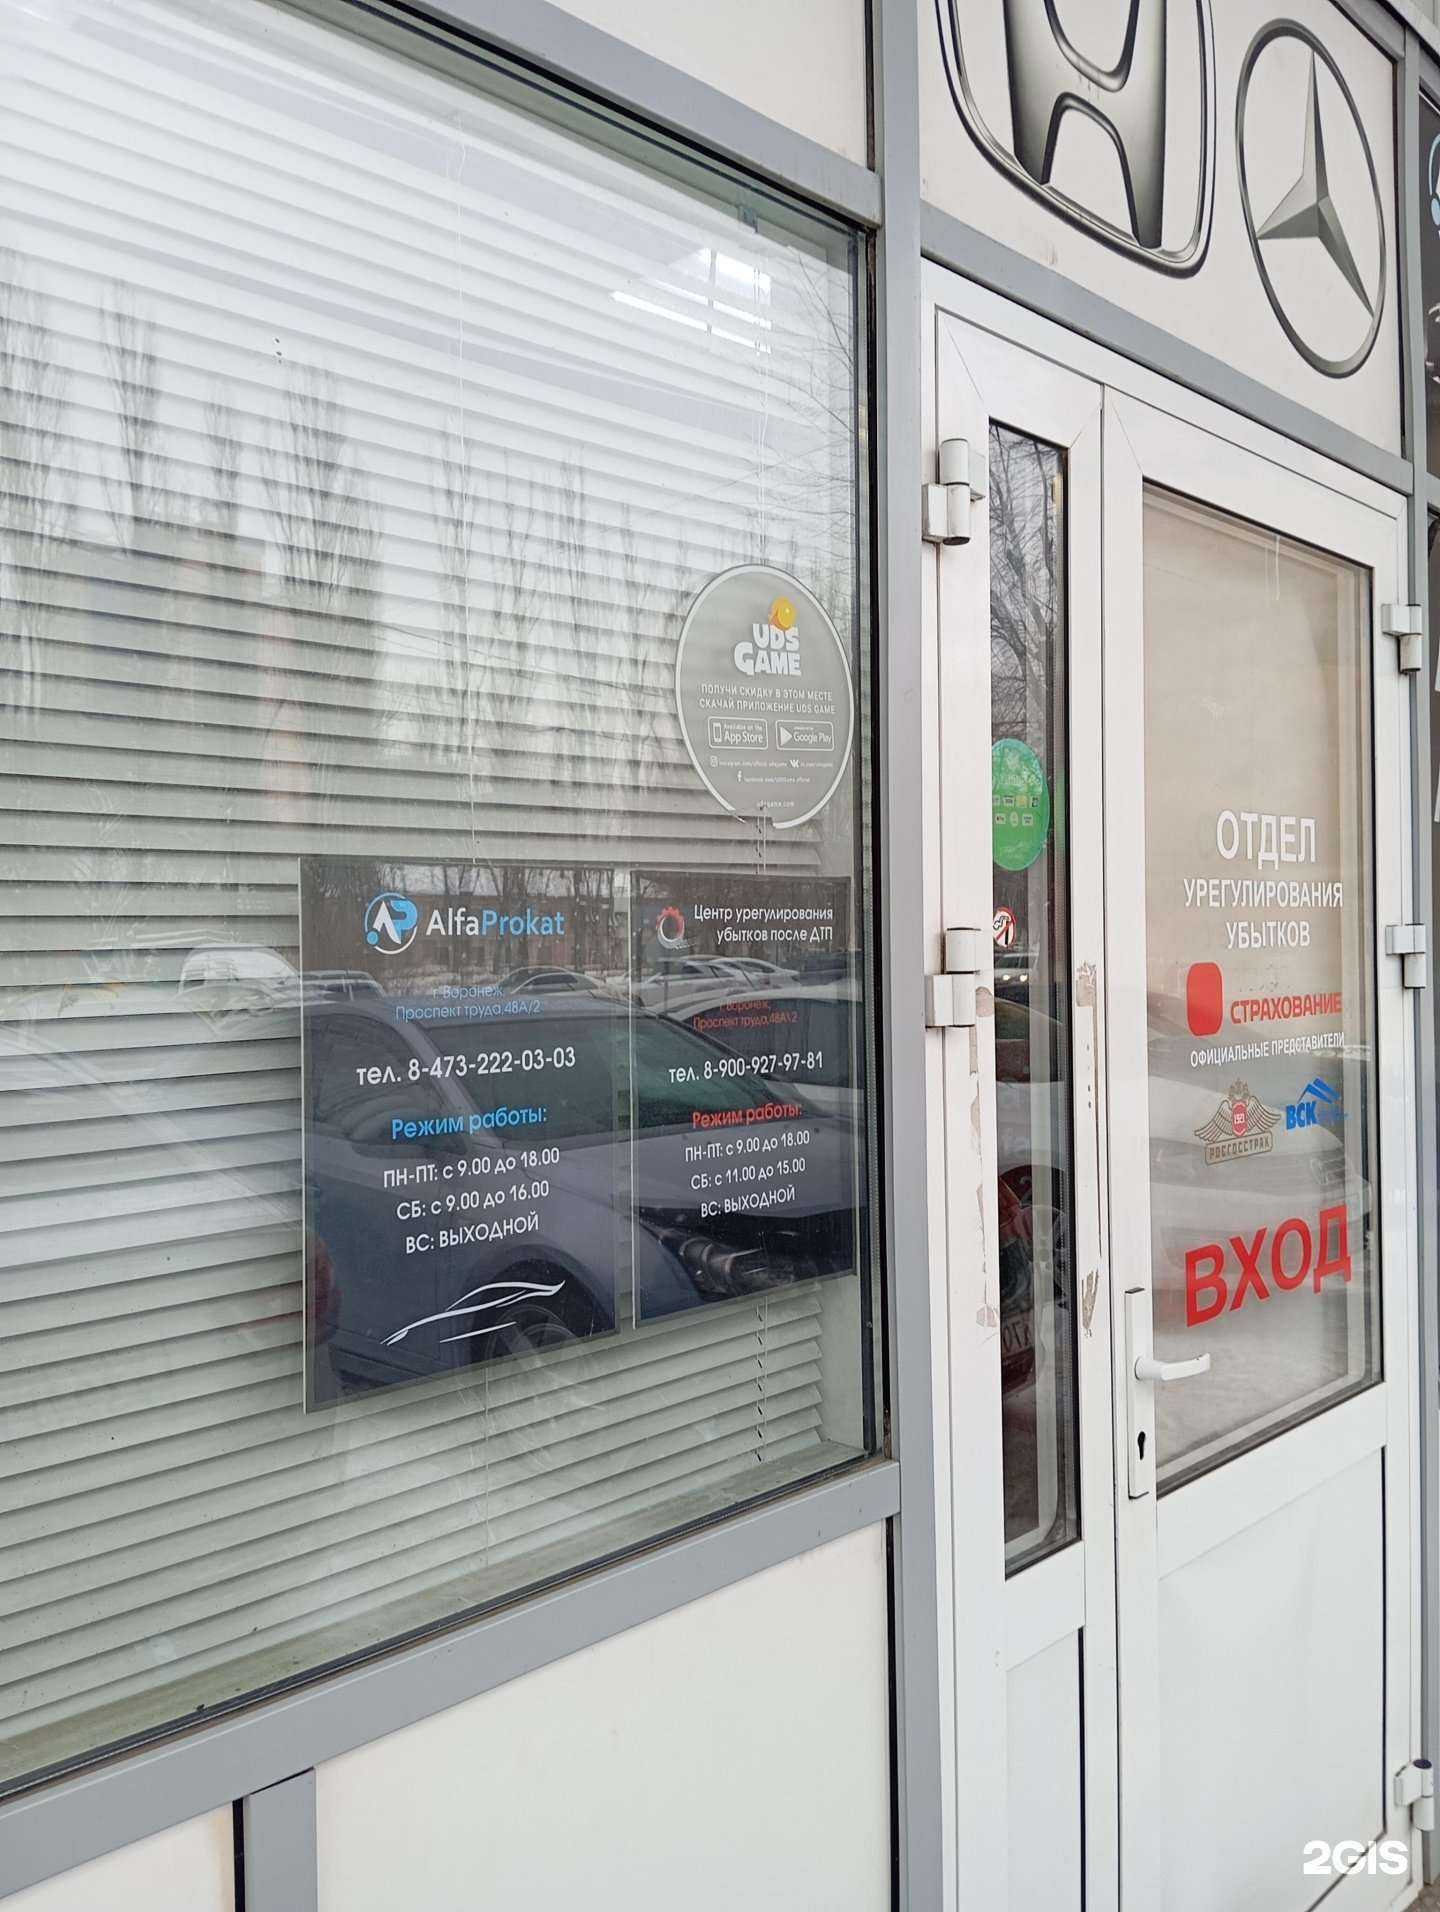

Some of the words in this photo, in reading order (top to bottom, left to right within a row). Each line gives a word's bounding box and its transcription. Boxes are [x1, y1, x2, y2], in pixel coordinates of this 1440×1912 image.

[752, 623, 799, 651] UDS
[734, 641, 801, 676] GAME
[699, 697, 735, 710] СКАЧАЙ
[737, 700, 794, 712] ПРИЛОЖЕНИЕ
[701, 683, 737, 695] ПОЛУЧИ
[740, 686, 773, 698] СКИДКУ
[775, 688, 781, 698] В
[784, 689, 805, 699] ЭТОМ
[807, 690, 832, 701] МЕСТЕ
[724, 730, 741, 745] App
[742, 730, 763, 744] Store
[793, 731, 817, 744] Google
[818, 732, 833, 744] Play
[1216, 809, 1317, 871] ОТДЕЛ
[1183, 878, 1344, 909] УРЕГУЛИРОВАНИЯ
[426, 906, 565, 936] AlfaProkat
[694, 904, 732, 921] Центр
[735, 906, 833, 922] урегулирования
[717, 927, 768, 945] убытков
[770, 928, 808, 942] после
[809, 926, 833, 942] ДТП
[1226, 920, 1311, 949] УБЫТКОВ
[395, 1005, 461, 1023] Проспект
[1230, 991, 1342, 1025] СТРАХОВАНИЕ
[1190, 1040, 1270, 1068] ОФИЦИАЛЬНЫЕ
[1271, 1031, 1345, 1057] ПРЕДСТАВИТЕЛИ
[356, 1066, 401, 1086] тел.
[408, 1046, 576, 1082] 8-473-222-03-03
[669, 1065, 700, 1083] тел.
[703, 1051, 823, 1079] 8-900-927-97-81
[391, 1115, 464, 1141] Режим
[469, 1106, 547, 1135] работы:
[692, 1109, 743, 1129] Режим
[746, 1103, 802, 1126] работы:
[1286, 1101, 1317, 1131] ВСК
[685, 1142, 723, 1162] ПН-ПТ:
[736, 1136, 760, 1155] 9.00
[762, 1136, 778, 1152] до
[781, 1130, 810, 1148] 18.00
[1209, 1136, 1271, 1160] РОСГОССТРАХ
[383, 1163, 438, 1188] ПН-ПТ:
[457, 1156, 491, 1178] 9.00
[494, 1157, 516, 1175] до
[520, 1147, 560, 1169] 18.00
[691, 1173, 712, 1191] СБ:
[726, 1165, 756, 1184] 11.00
[758, 1166, 774, 1181] до
[776, 1157, 806, 1175] 15.00
[396, 1199, 427, 1221] СБ:
[446, 1190, 480, 1213] 9.00
[483, 1190, 505, 1209] до
[509, 1180, 549, 1202] 16.00
[701, 1201, 722, 1218] ВС:
[724, 1184, 796, 1214] ВЫХОДНОЙ
[406, 1233, 435, 1255] ВС:
[439, 1211, 539, 1249] ВЫХОДНОЙ
[1184, 1204, 1352, 1327] ВХОД
